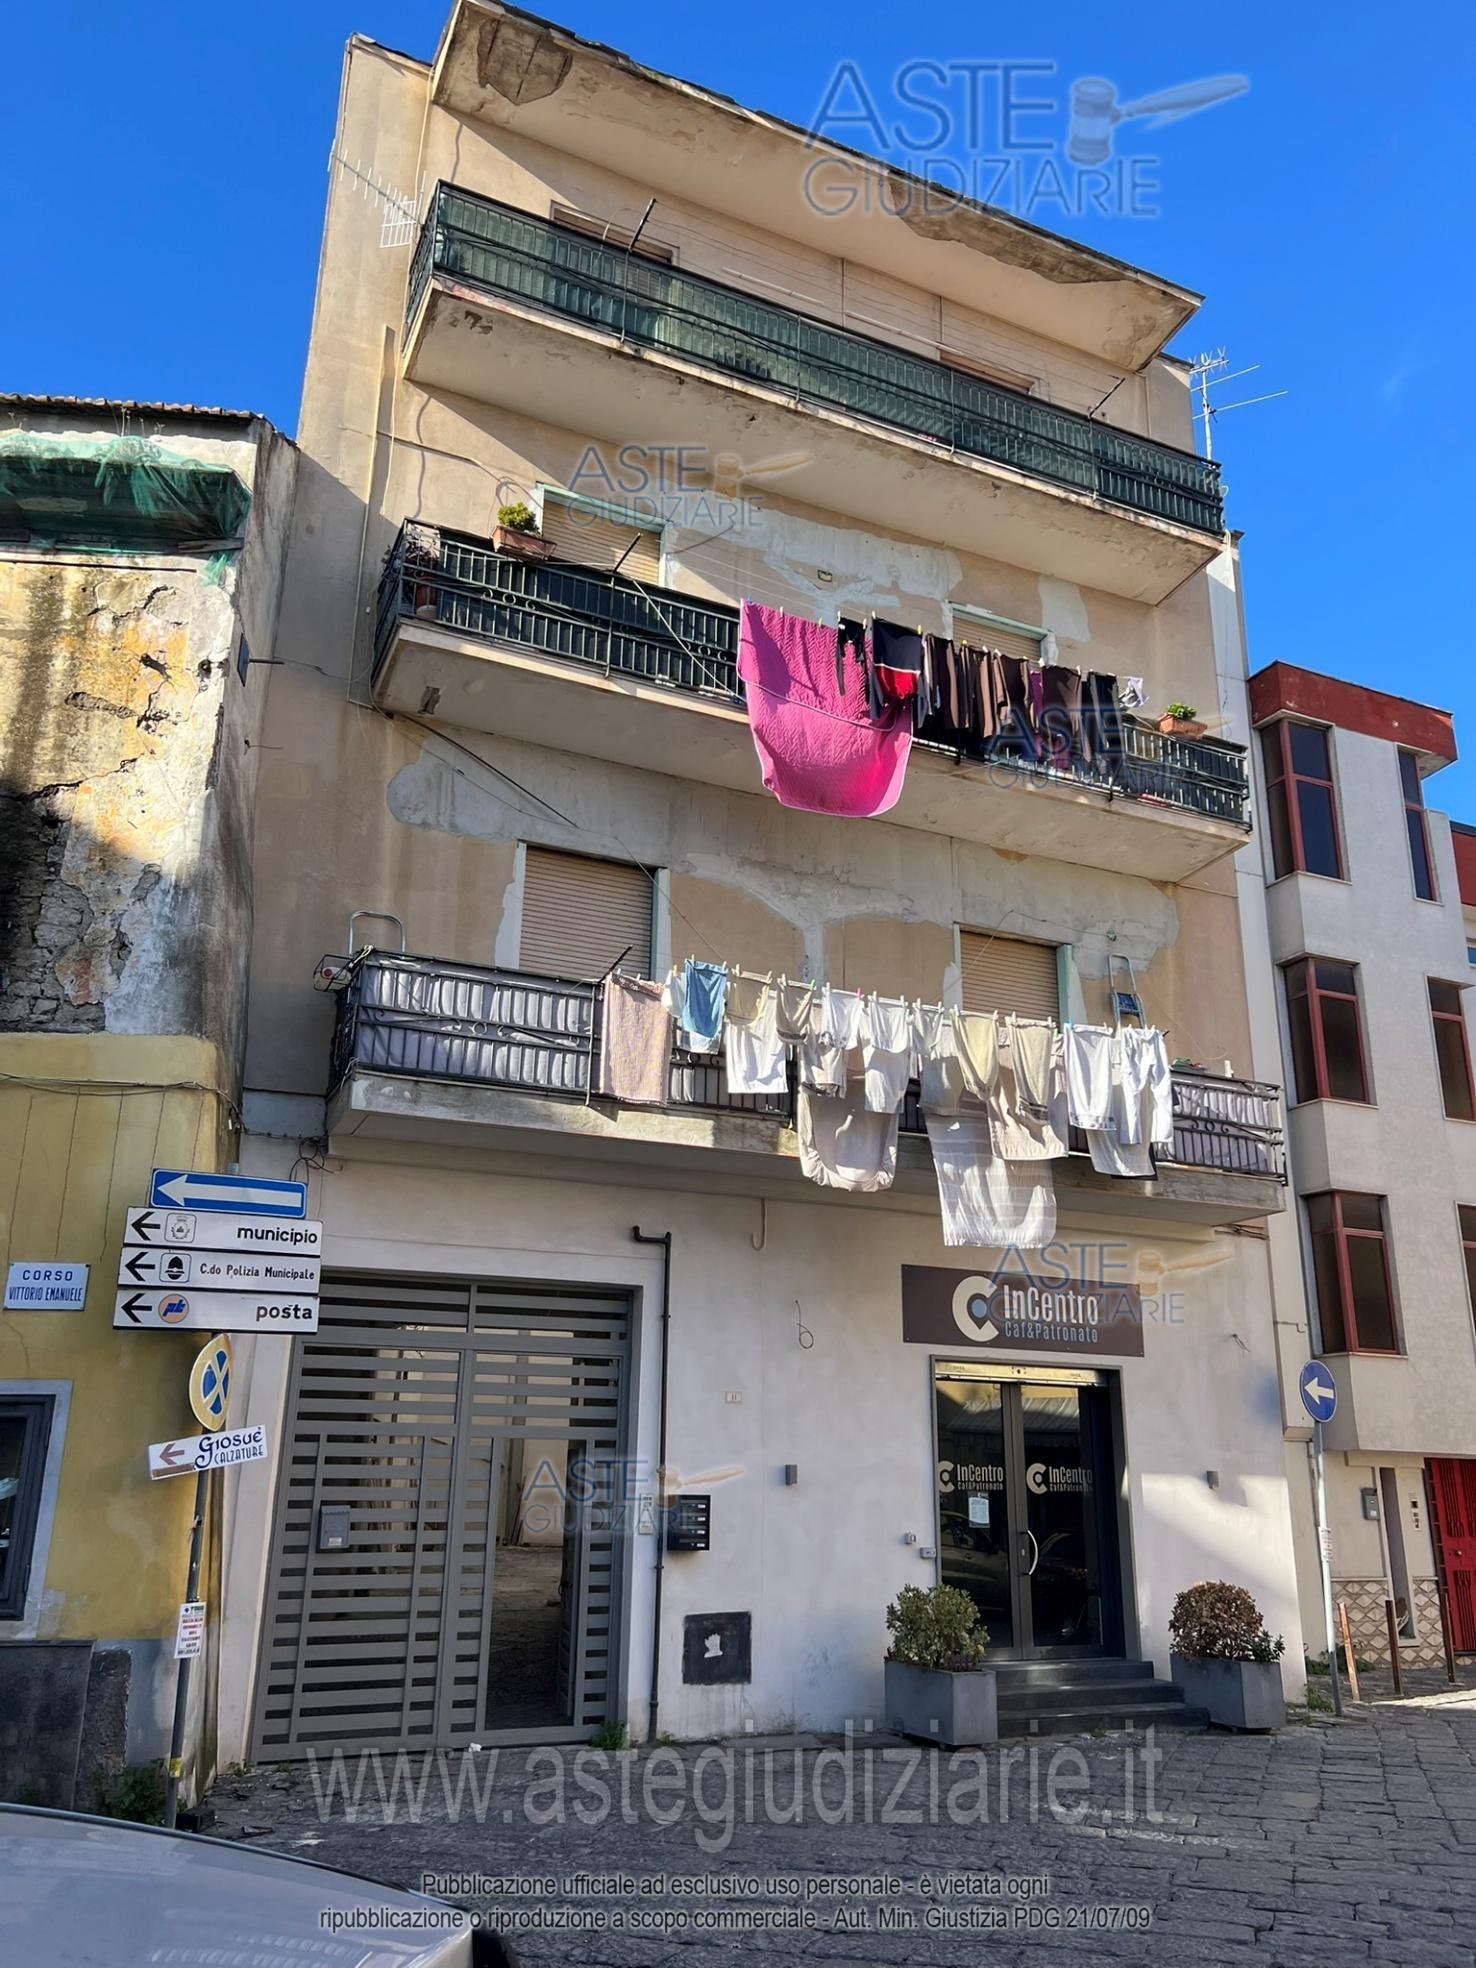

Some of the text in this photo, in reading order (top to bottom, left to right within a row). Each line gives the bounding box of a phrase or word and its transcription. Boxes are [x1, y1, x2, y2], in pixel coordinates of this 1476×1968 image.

[237, 1226, 318, 1245] municipio
[22, 1270, 74, 1281] CORSO
[200, 1263, 315, 1281] C.do Polizia Municipale
[9, 1287, 83, 1301] VITTORIO EMANUELE
[256, 1304, 313, 1322] posta
[1003, 1284, 1098, 1325] InCentro
[1004, 1320, 1098, 1343] Caf&Patronato
[214, 1445, 264, 1464] CALZATURE
[957, 1464, 1004, 1482] InCentro
[1048, 1466, 1094, 1484] InCentro
